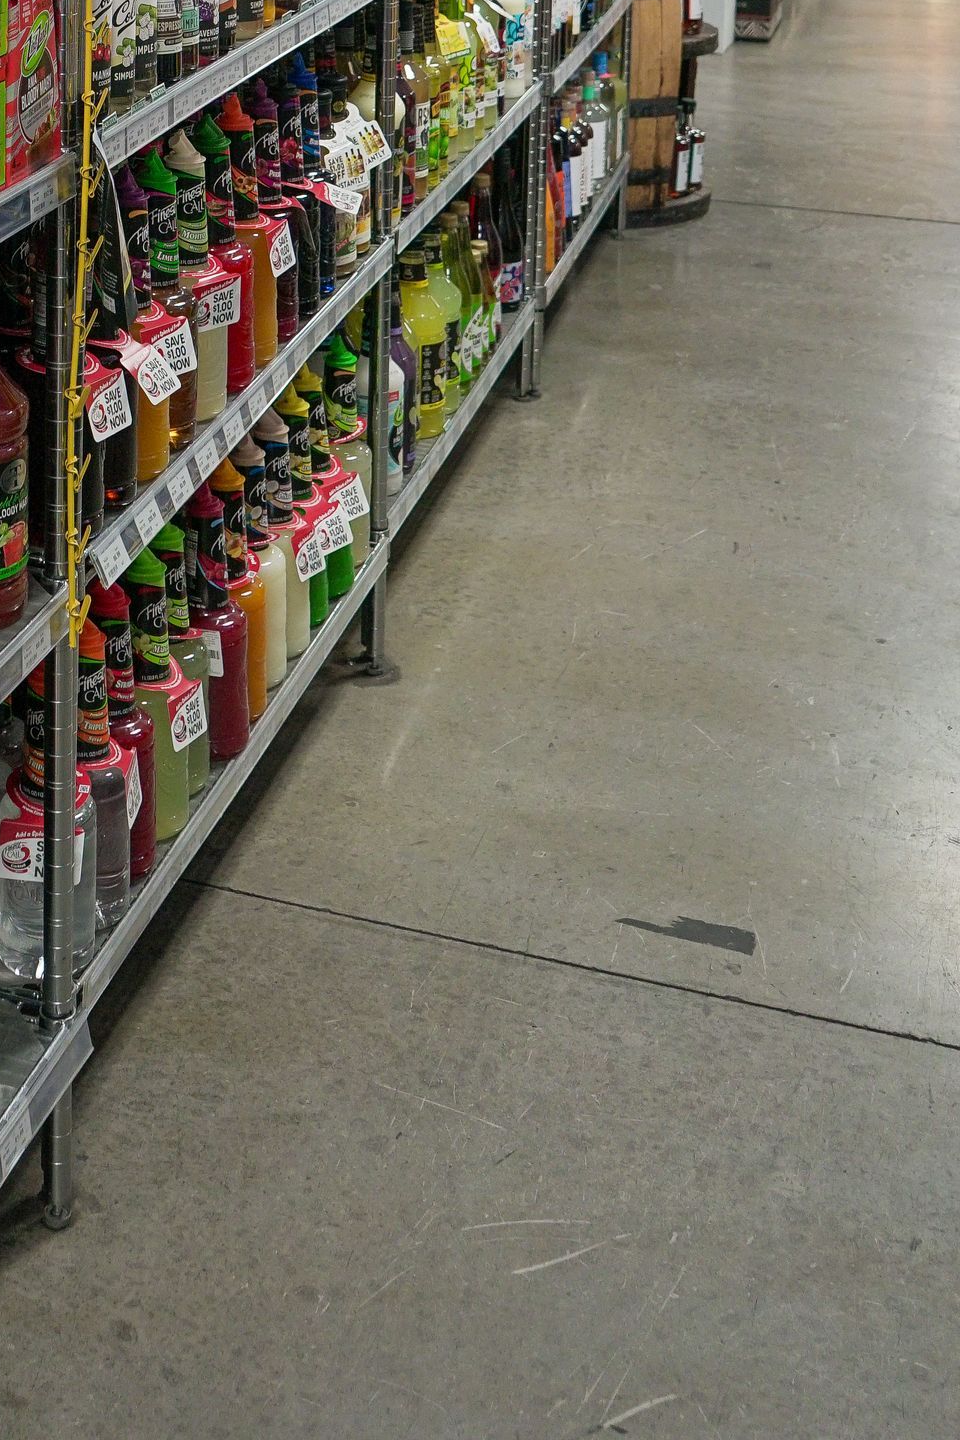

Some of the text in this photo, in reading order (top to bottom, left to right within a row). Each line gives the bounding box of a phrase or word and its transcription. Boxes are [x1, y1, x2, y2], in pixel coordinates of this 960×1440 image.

[328, 155, 343, 167] SAVE
[183, 198, 205, 215] CALL
[278, 234, 288, 248] SAVE
[282, 253, 293, 268] NOW
[213, 289, 234, 302] SAVE
[213, 301, 233, 313] $1.00
[212, 311, 234, 326] NOW
[164, 333, 186, 349] SAVE
[167, 346, 187, 360] $1.00
[145, 357, 162, 372] SAVE
[170, 357, 191, 374] NOW
[153, 368, 168, 381] $1.00
[159, 378, 175, 394] NOW
[104, 386, 122, 402] SAVE
[106, 399, 123, 415] $1.00
[109, 413, 127, 430] NOW
[340, 485, 358, 499] SAVE
[343, 496, 360, 508] $1.00
[346, 504, 365, 518] NOW
[325, 515, 342, 529] SAVE
[329, 525, 344, 538] $1.00
[306, 539, 318, 553] SAVE
[332, 534, 349, 548] NOW
[309, 559, 323, 573] NOW
[84, 684, 107, 703] CALL
[185, 697, 200, 711] SAVE
[188, 720, 203, 738] NOW
